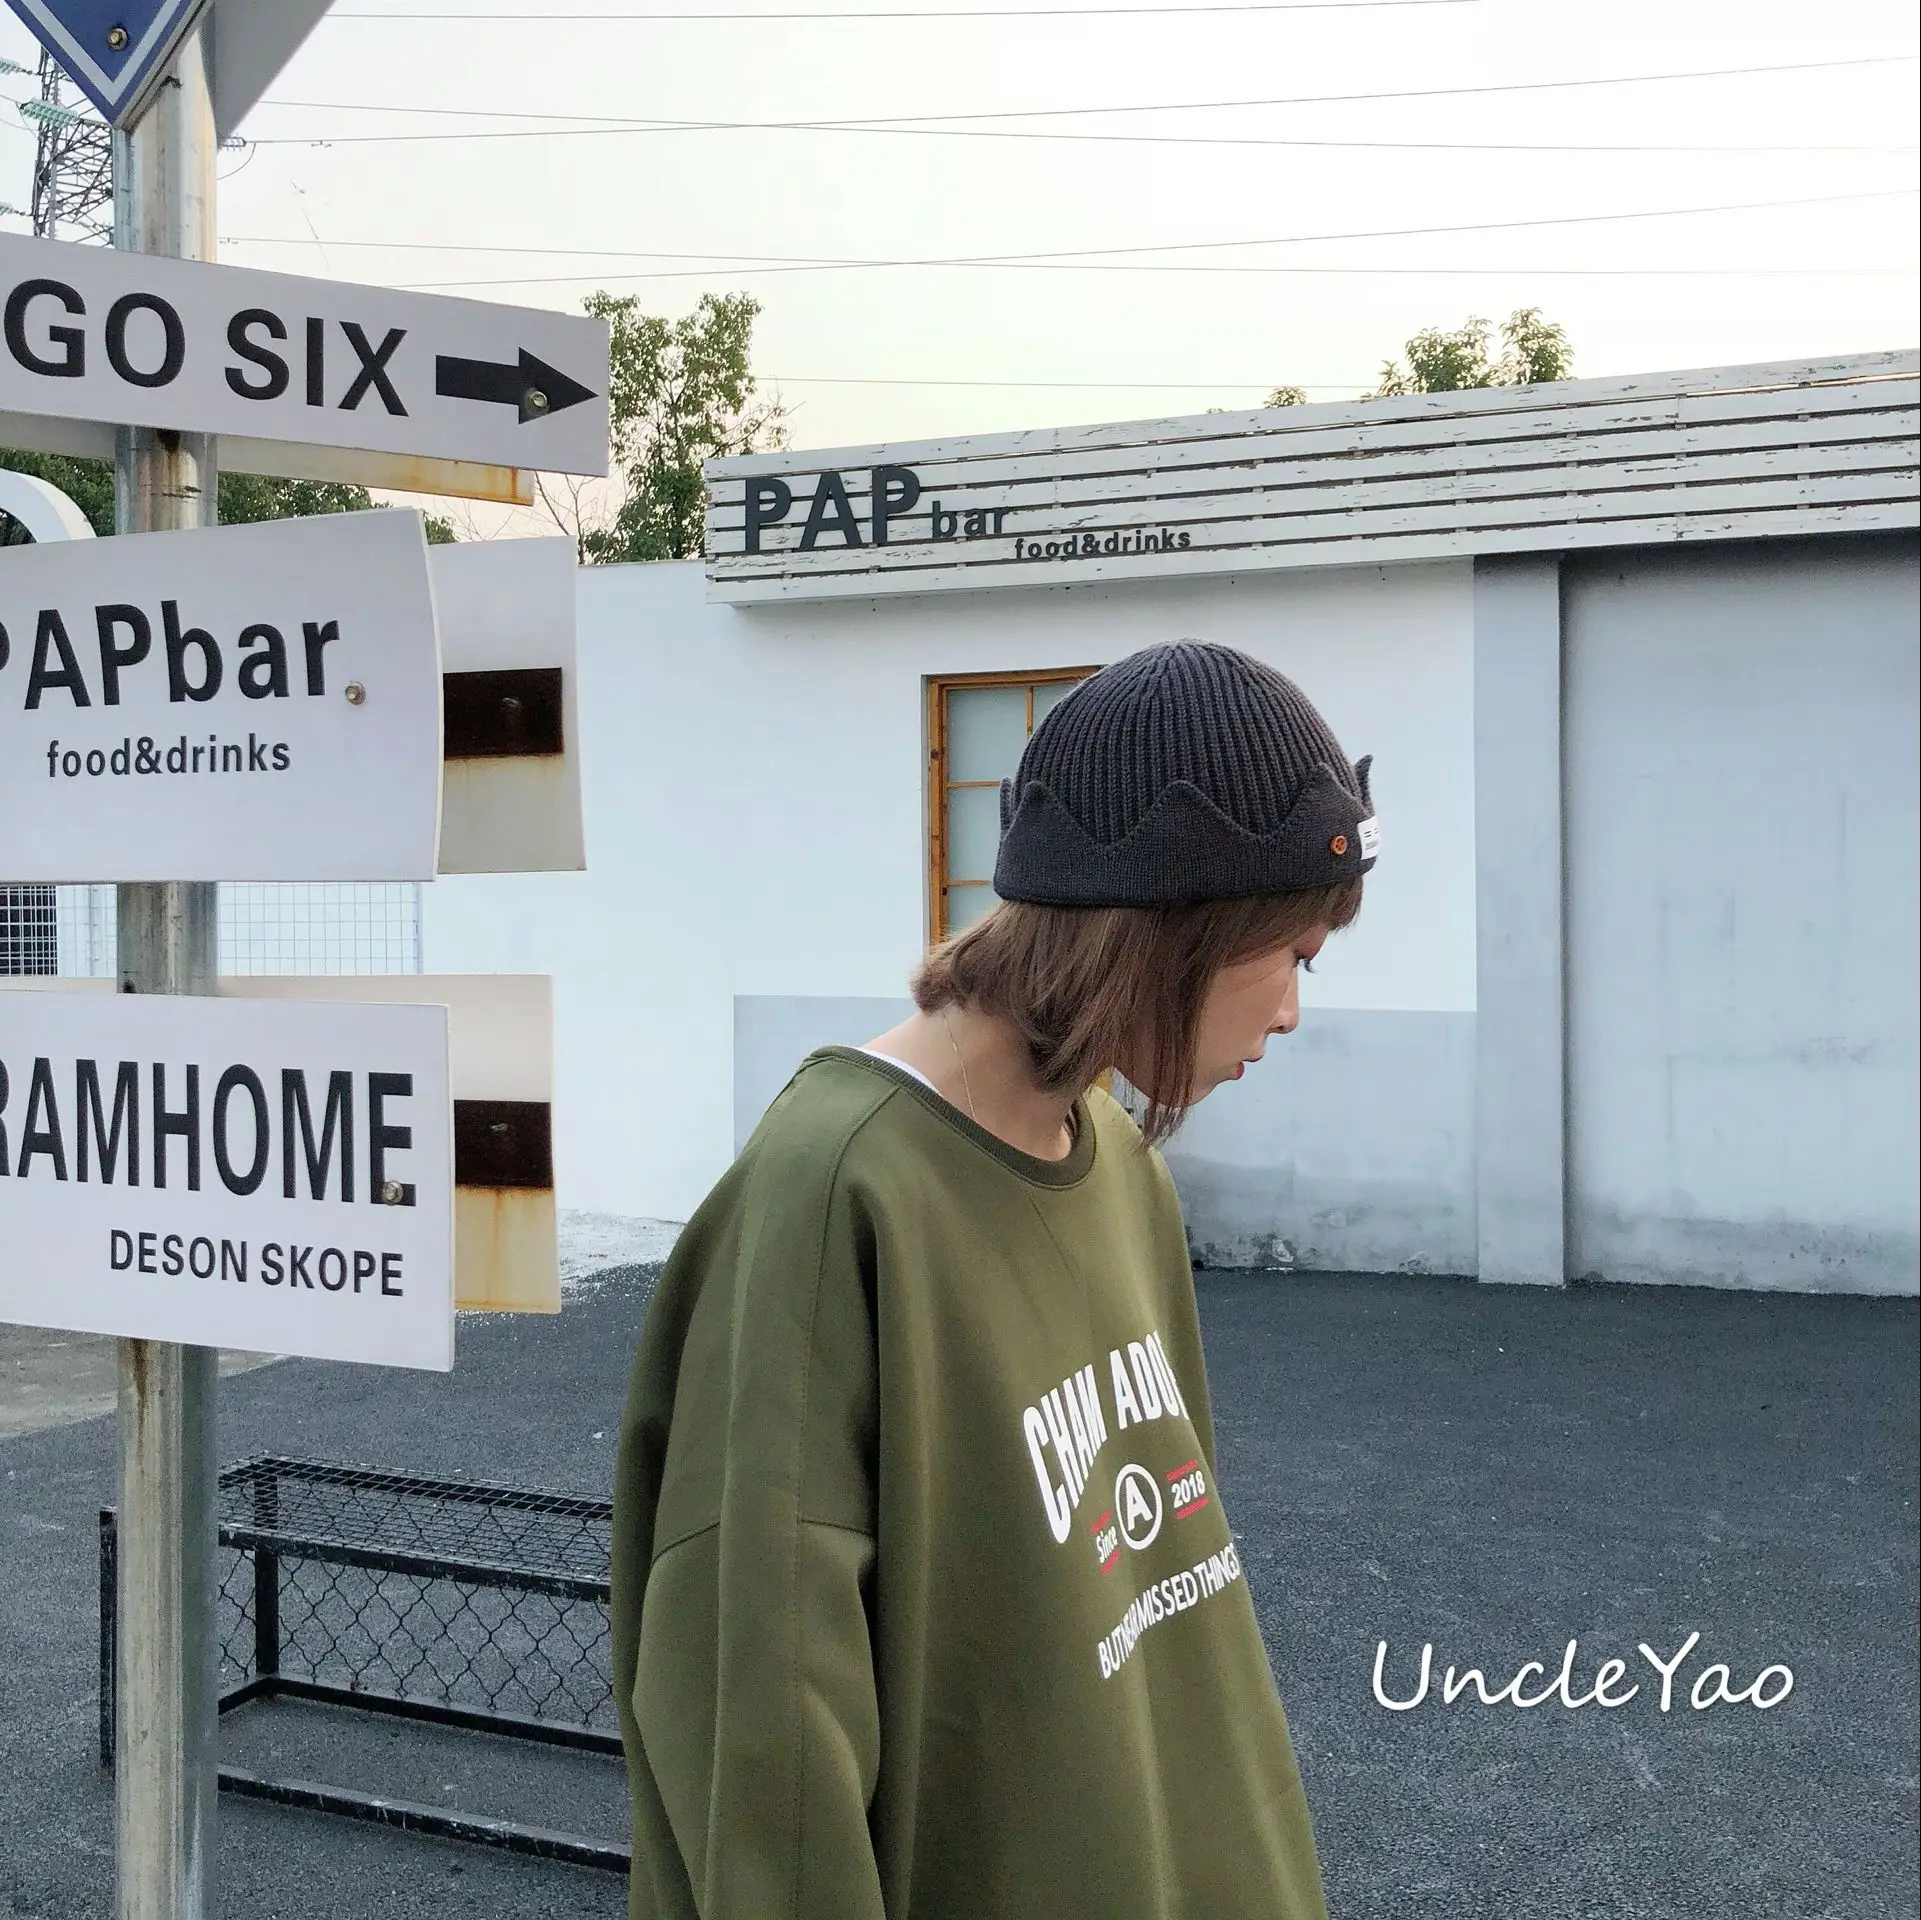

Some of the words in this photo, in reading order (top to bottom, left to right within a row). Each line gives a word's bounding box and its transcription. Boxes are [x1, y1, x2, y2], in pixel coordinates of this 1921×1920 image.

[4, 278, 186, 388] GO
[224, 308, 409, 417] SIX
[745, 466, 920, 551] PAP
[1015, 528, 1191, 559] food&drinks
[0, 600, 340, 710] APbar
[47, 733, 291, 778] food&drinks
[0, 1056, 416, 1207] AMHOME
[110, 1229, 248, 1282] DESON
[260, 1242, 404, 1296] SKOPE
[1023, 1364, 1108, 1543] CHAM
[1171, 1471, 1205, 1508] 2018
